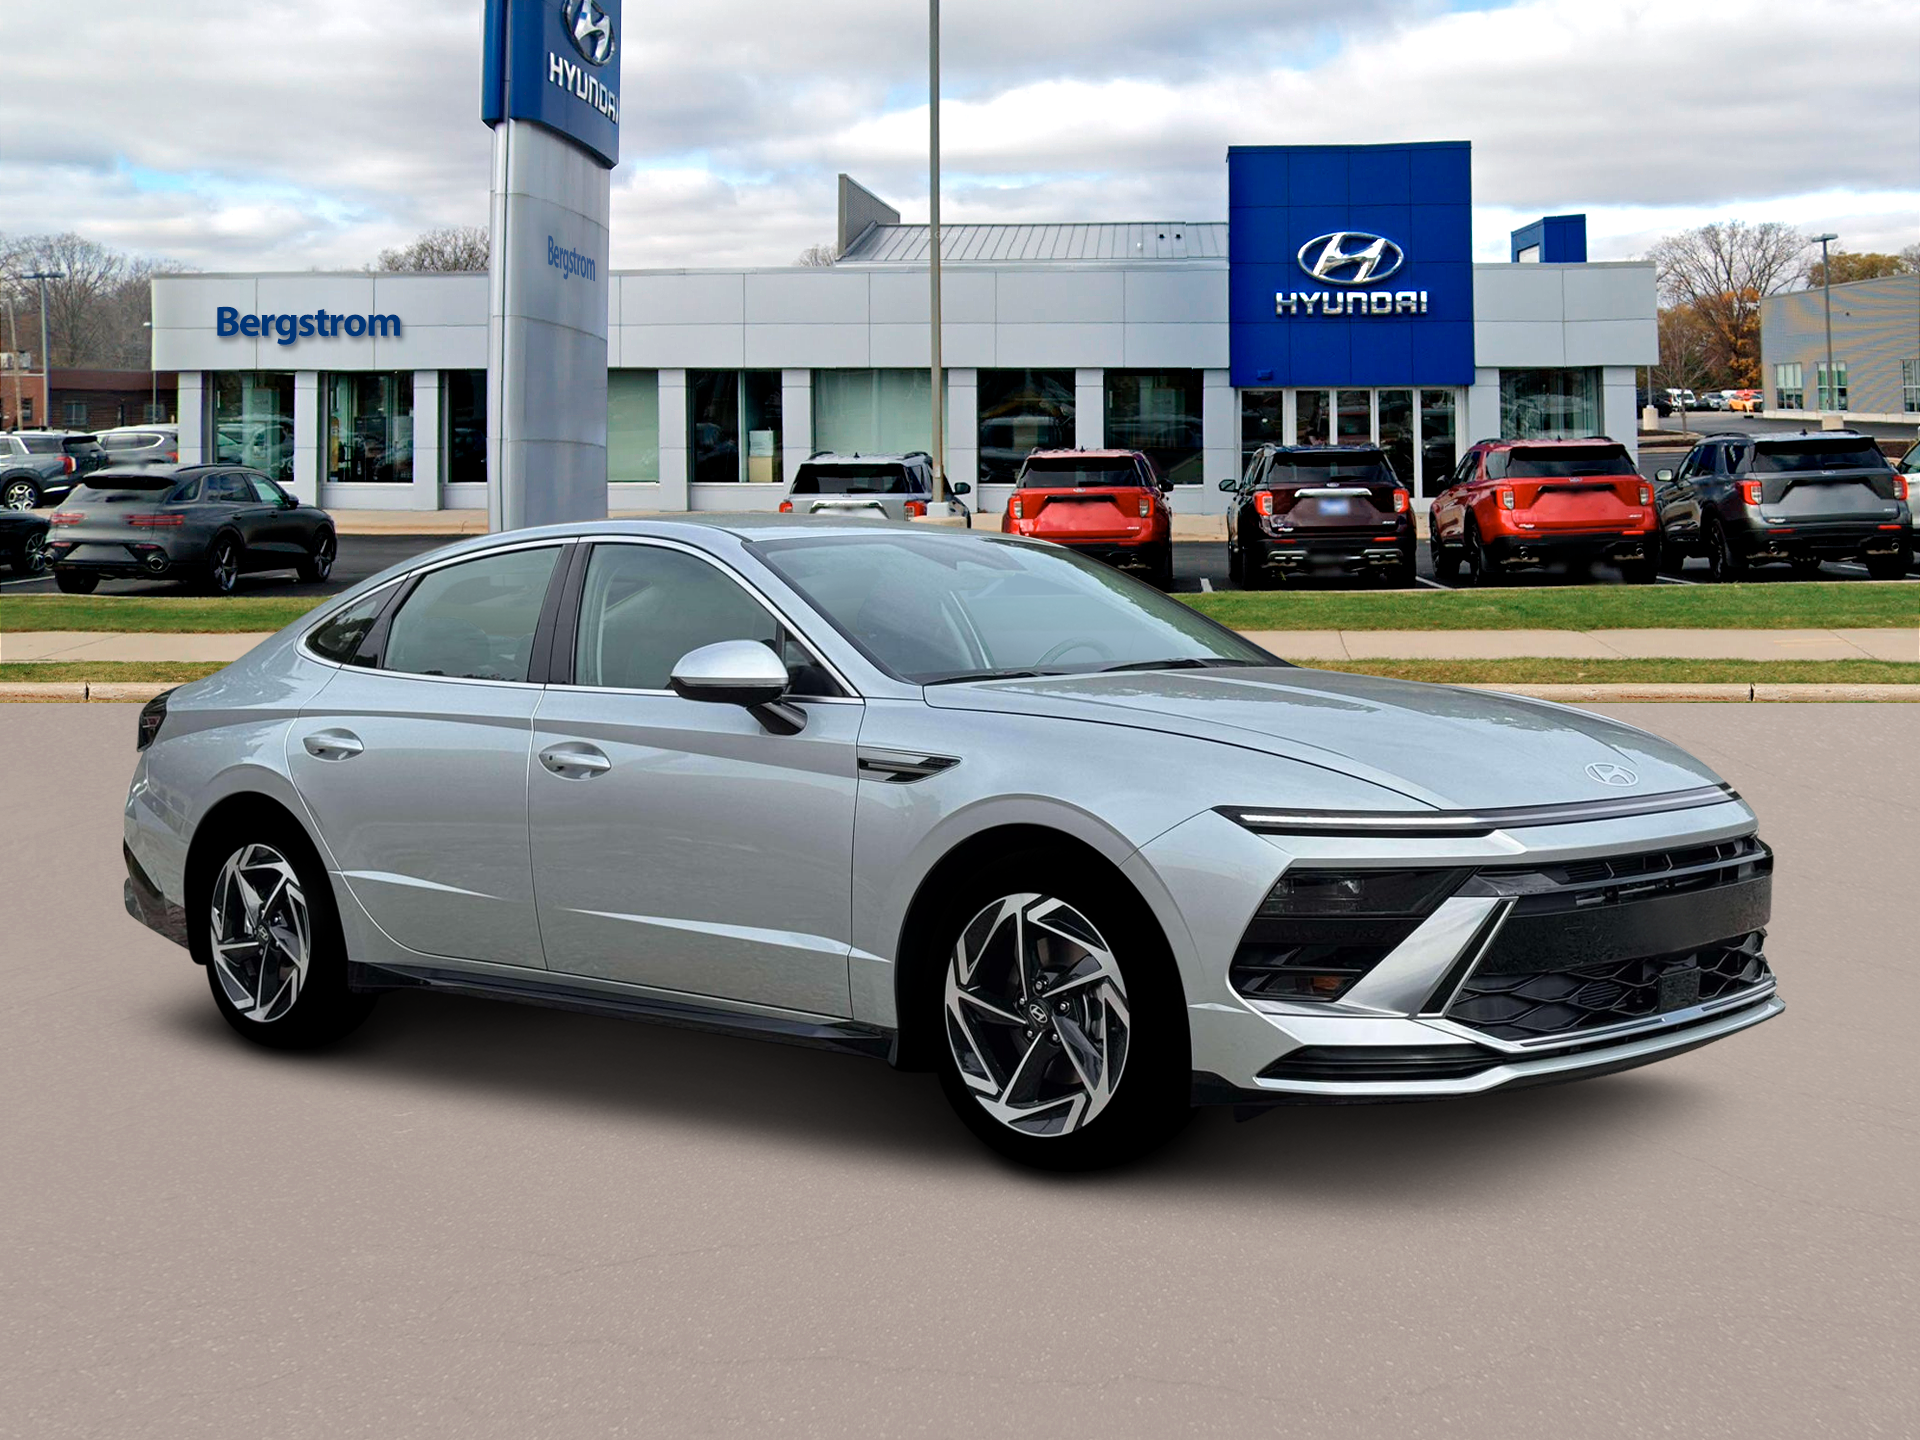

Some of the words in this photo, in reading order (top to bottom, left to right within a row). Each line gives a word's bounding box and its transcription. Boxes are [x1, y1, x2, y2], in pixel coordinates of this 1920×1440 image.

[549, 52, 618, 124] HYUNDAI
[547, 235, 596, 281] Bergstrom
[1275, 290, 1428, 315] HYUNDAI
[216, 306, 401, 346] Bergstrom
